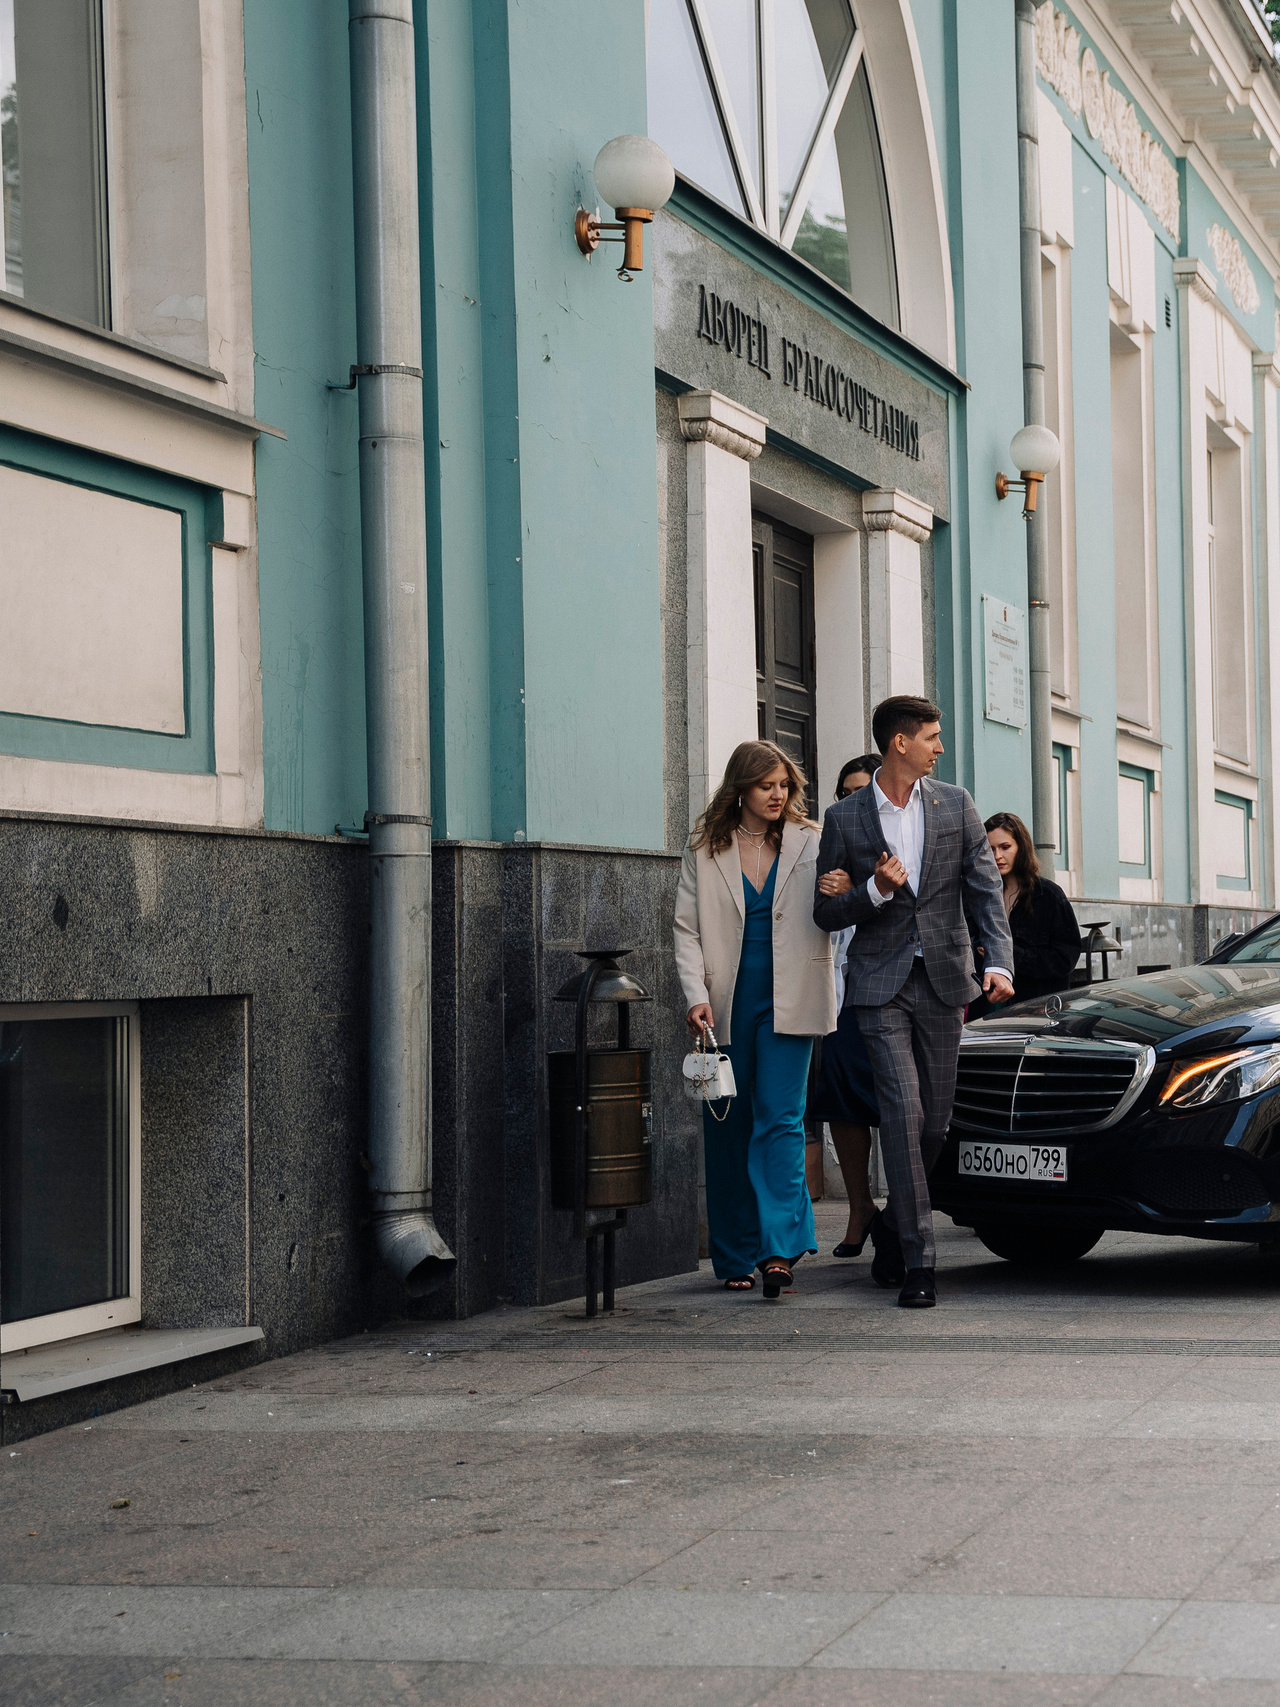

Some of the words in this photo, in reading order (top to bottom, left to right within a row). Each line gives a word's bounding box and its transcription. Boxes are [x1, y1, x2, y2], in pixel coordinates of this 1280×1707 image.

[697, 284, 771, 380] ДВОРЕЦ
[782, 337, 919, 461] БРАКОСОЧЕТАНИЯ
[1031, 1147, 1061, 1169] 799
[1038, 1168, 1053, 1177] RUS
